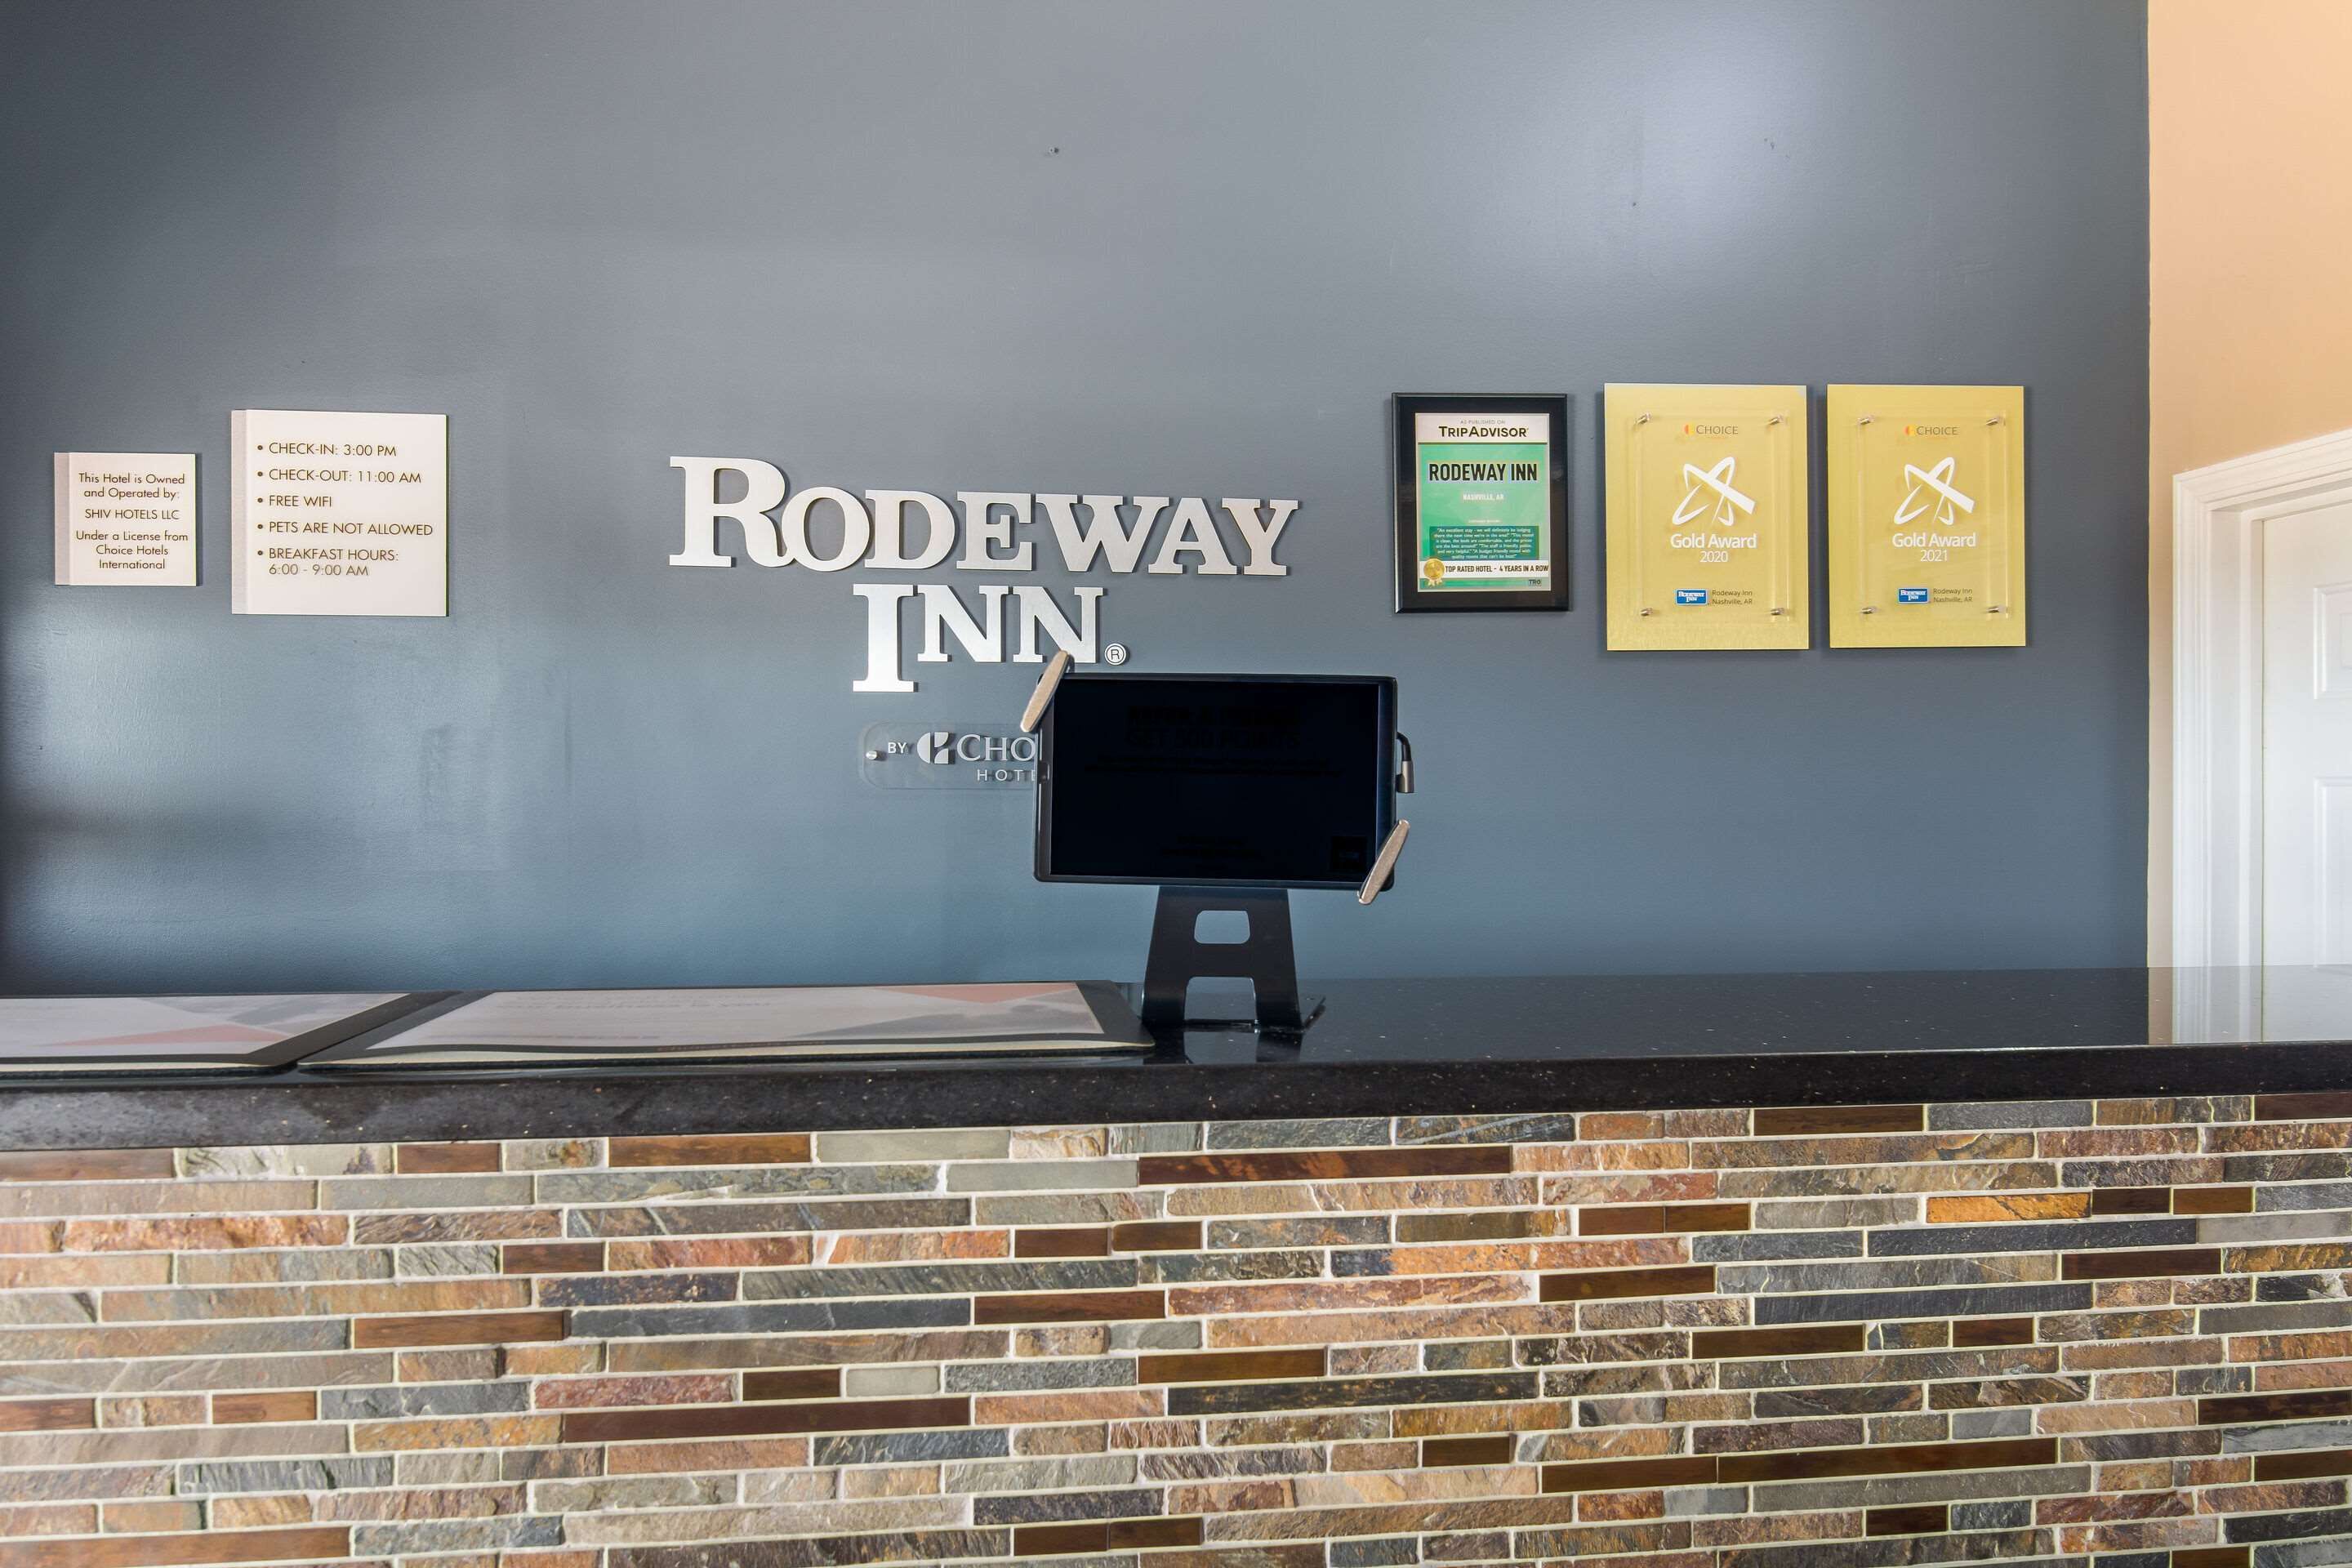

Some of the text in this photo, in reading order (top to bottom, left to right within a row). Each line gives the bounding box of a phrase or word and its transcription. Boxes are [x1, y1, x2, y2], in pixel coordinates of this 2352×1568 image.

[1696, 425, 1739, 434] CHOICE
[1916, 426, 1960, 435] CHOICE
[269, 443, 397, 457] CHECK-IN: 3:00 PM
[78, 473, 185, 483] This Hotel is Owned
[269, 469, 422, 484] CHECK-OUT: 11:00 AM
[1429, 464, 1538, 481] RODEWAY INN
[84, 487, 180, 501] and Operated by:
[269, 495, 333, 508] FREE WIFI
[85, 508, 180, 520] SHIV HOTELS LLC
[669, 455, 1299, 577] RODEWAY
[76, 530, 109, 541] Under
[123, 530, 161, 541] License
[164, 530, 189, 541] from
[269, 522, 433, 536] PETS ARE NOT ALLOWED
[1670, 533, 1757, 548] Gold Award
[1892, 532, 1976, 548] Gold Award
[96, 544, 169, 556] Choice Hotels
[269, 548, 399, 561] BREAKFAST HOURS:
[1699, 550, 1728, 562] 2020
[1920, 549, 1948, 562] 2021
[99, 558, 166, 570] International
[269, 564, 298, 576] 6:00
[312, 564, 341, 576] 9:00
[345, 564, 369, 577] AM
[853, 584, 1104, 693] INN
[888, 742, 906, 754] BY
